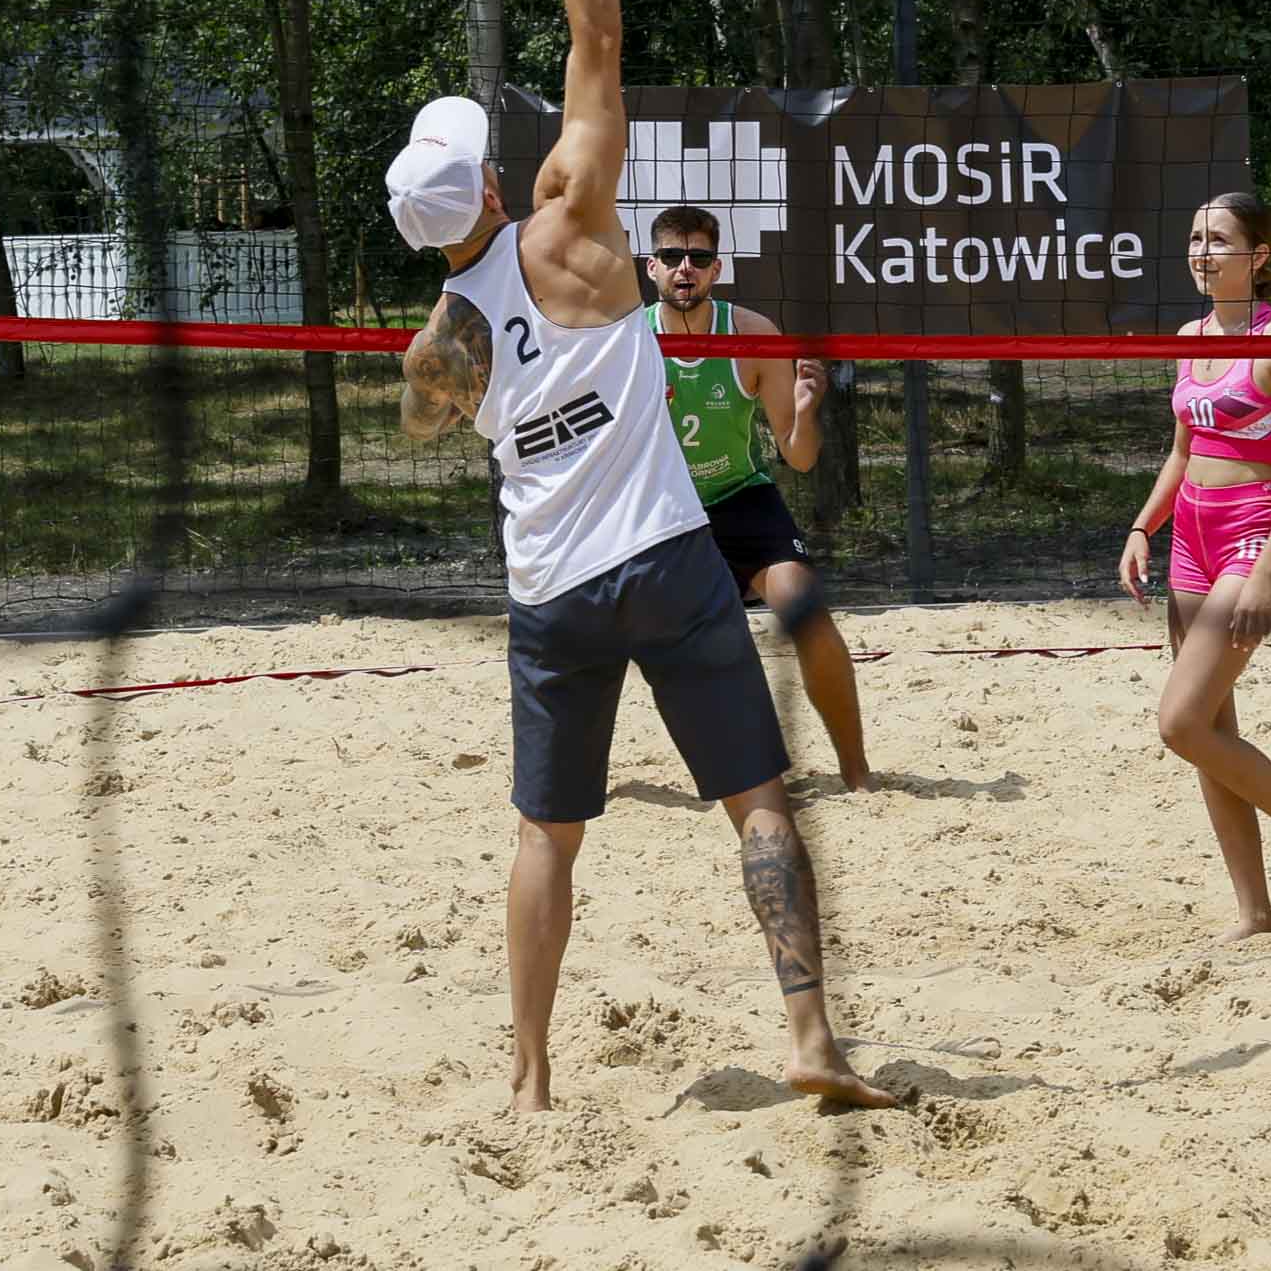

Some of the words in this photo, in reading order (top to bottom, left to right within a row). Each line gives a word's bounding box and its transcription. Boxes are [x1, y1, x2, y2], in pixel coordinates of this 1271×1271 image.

[834, 142, 1068, 206] MOSiR
[835, 218, 1144, 285] Katowice
[504, 316, 541, 365] 2
[682, 415, 700, 447] 2
[1186, 397, 1216, 427] 10
